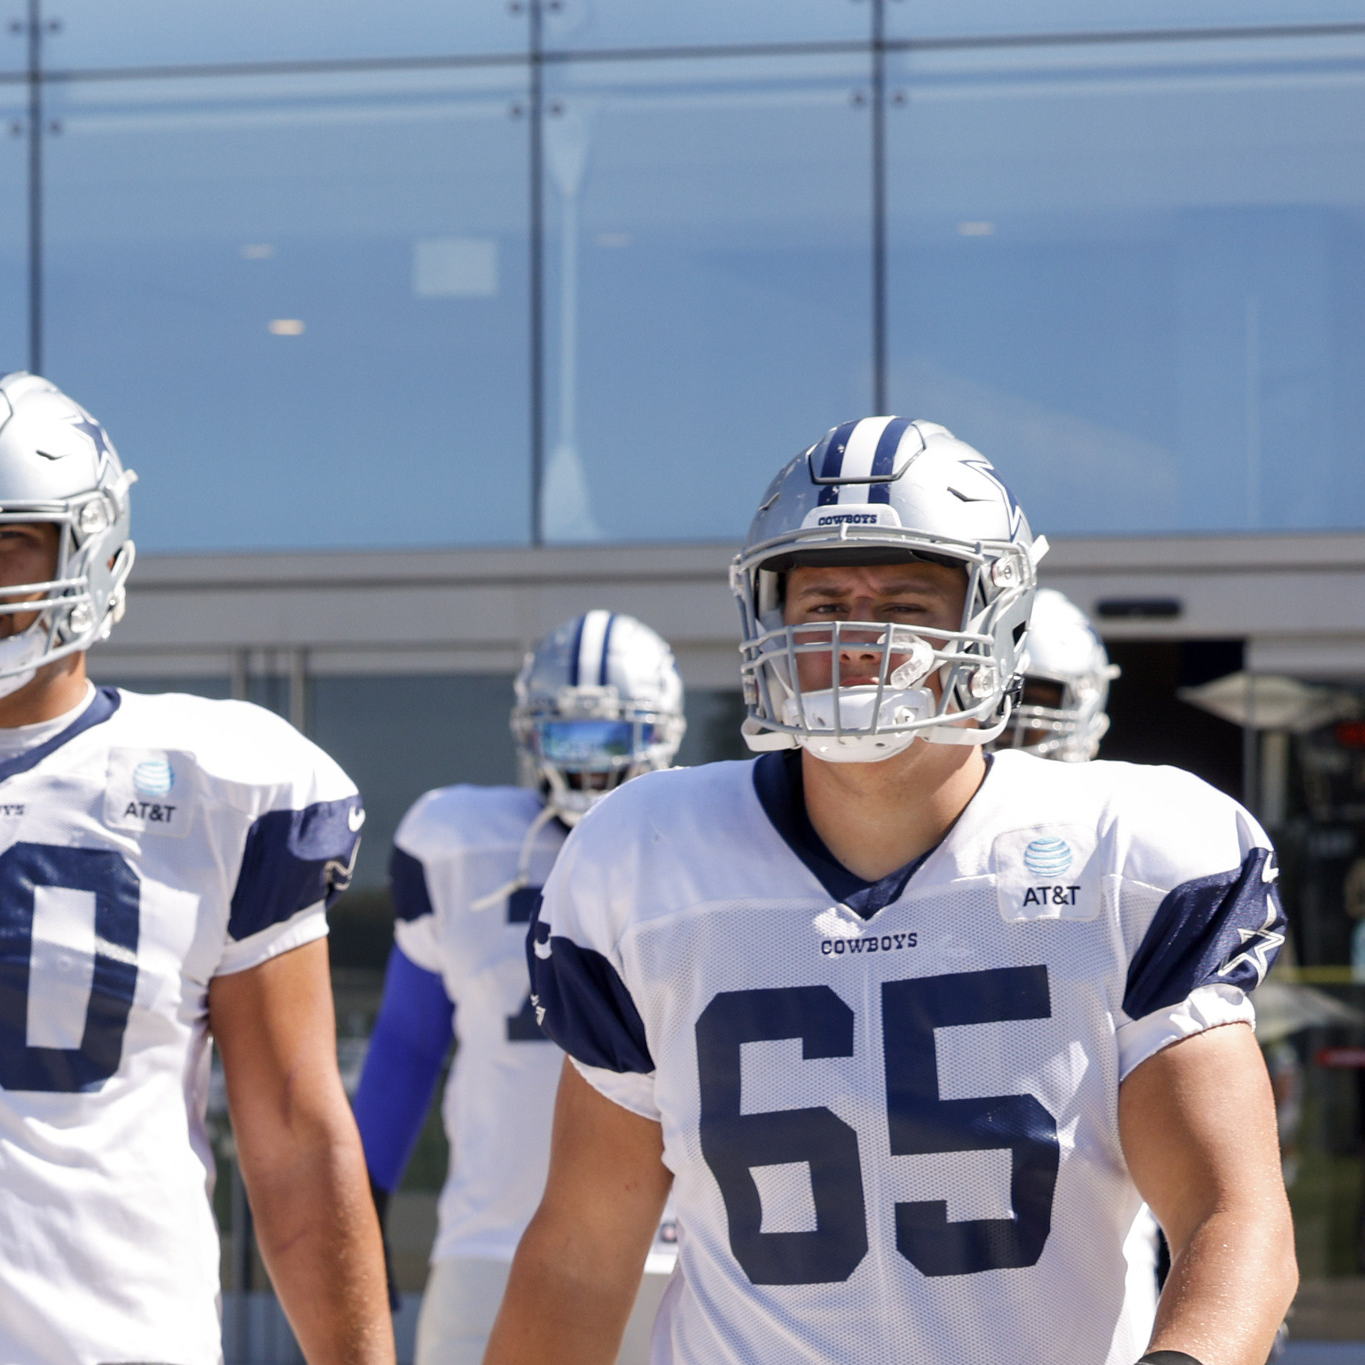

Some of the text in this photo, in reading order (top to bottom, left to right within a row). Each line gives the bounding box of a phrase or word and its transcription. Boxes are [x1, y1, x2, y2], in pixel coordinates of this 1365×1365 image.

[818, 514, 878, 526] COWBOYS
[123, 802, 176, 822] AT&T
[1023, 886, 1081, 907] AT&T
[821, 933, 918, 955] COWBOYS
[695, 965, 1061, 1286] 65
